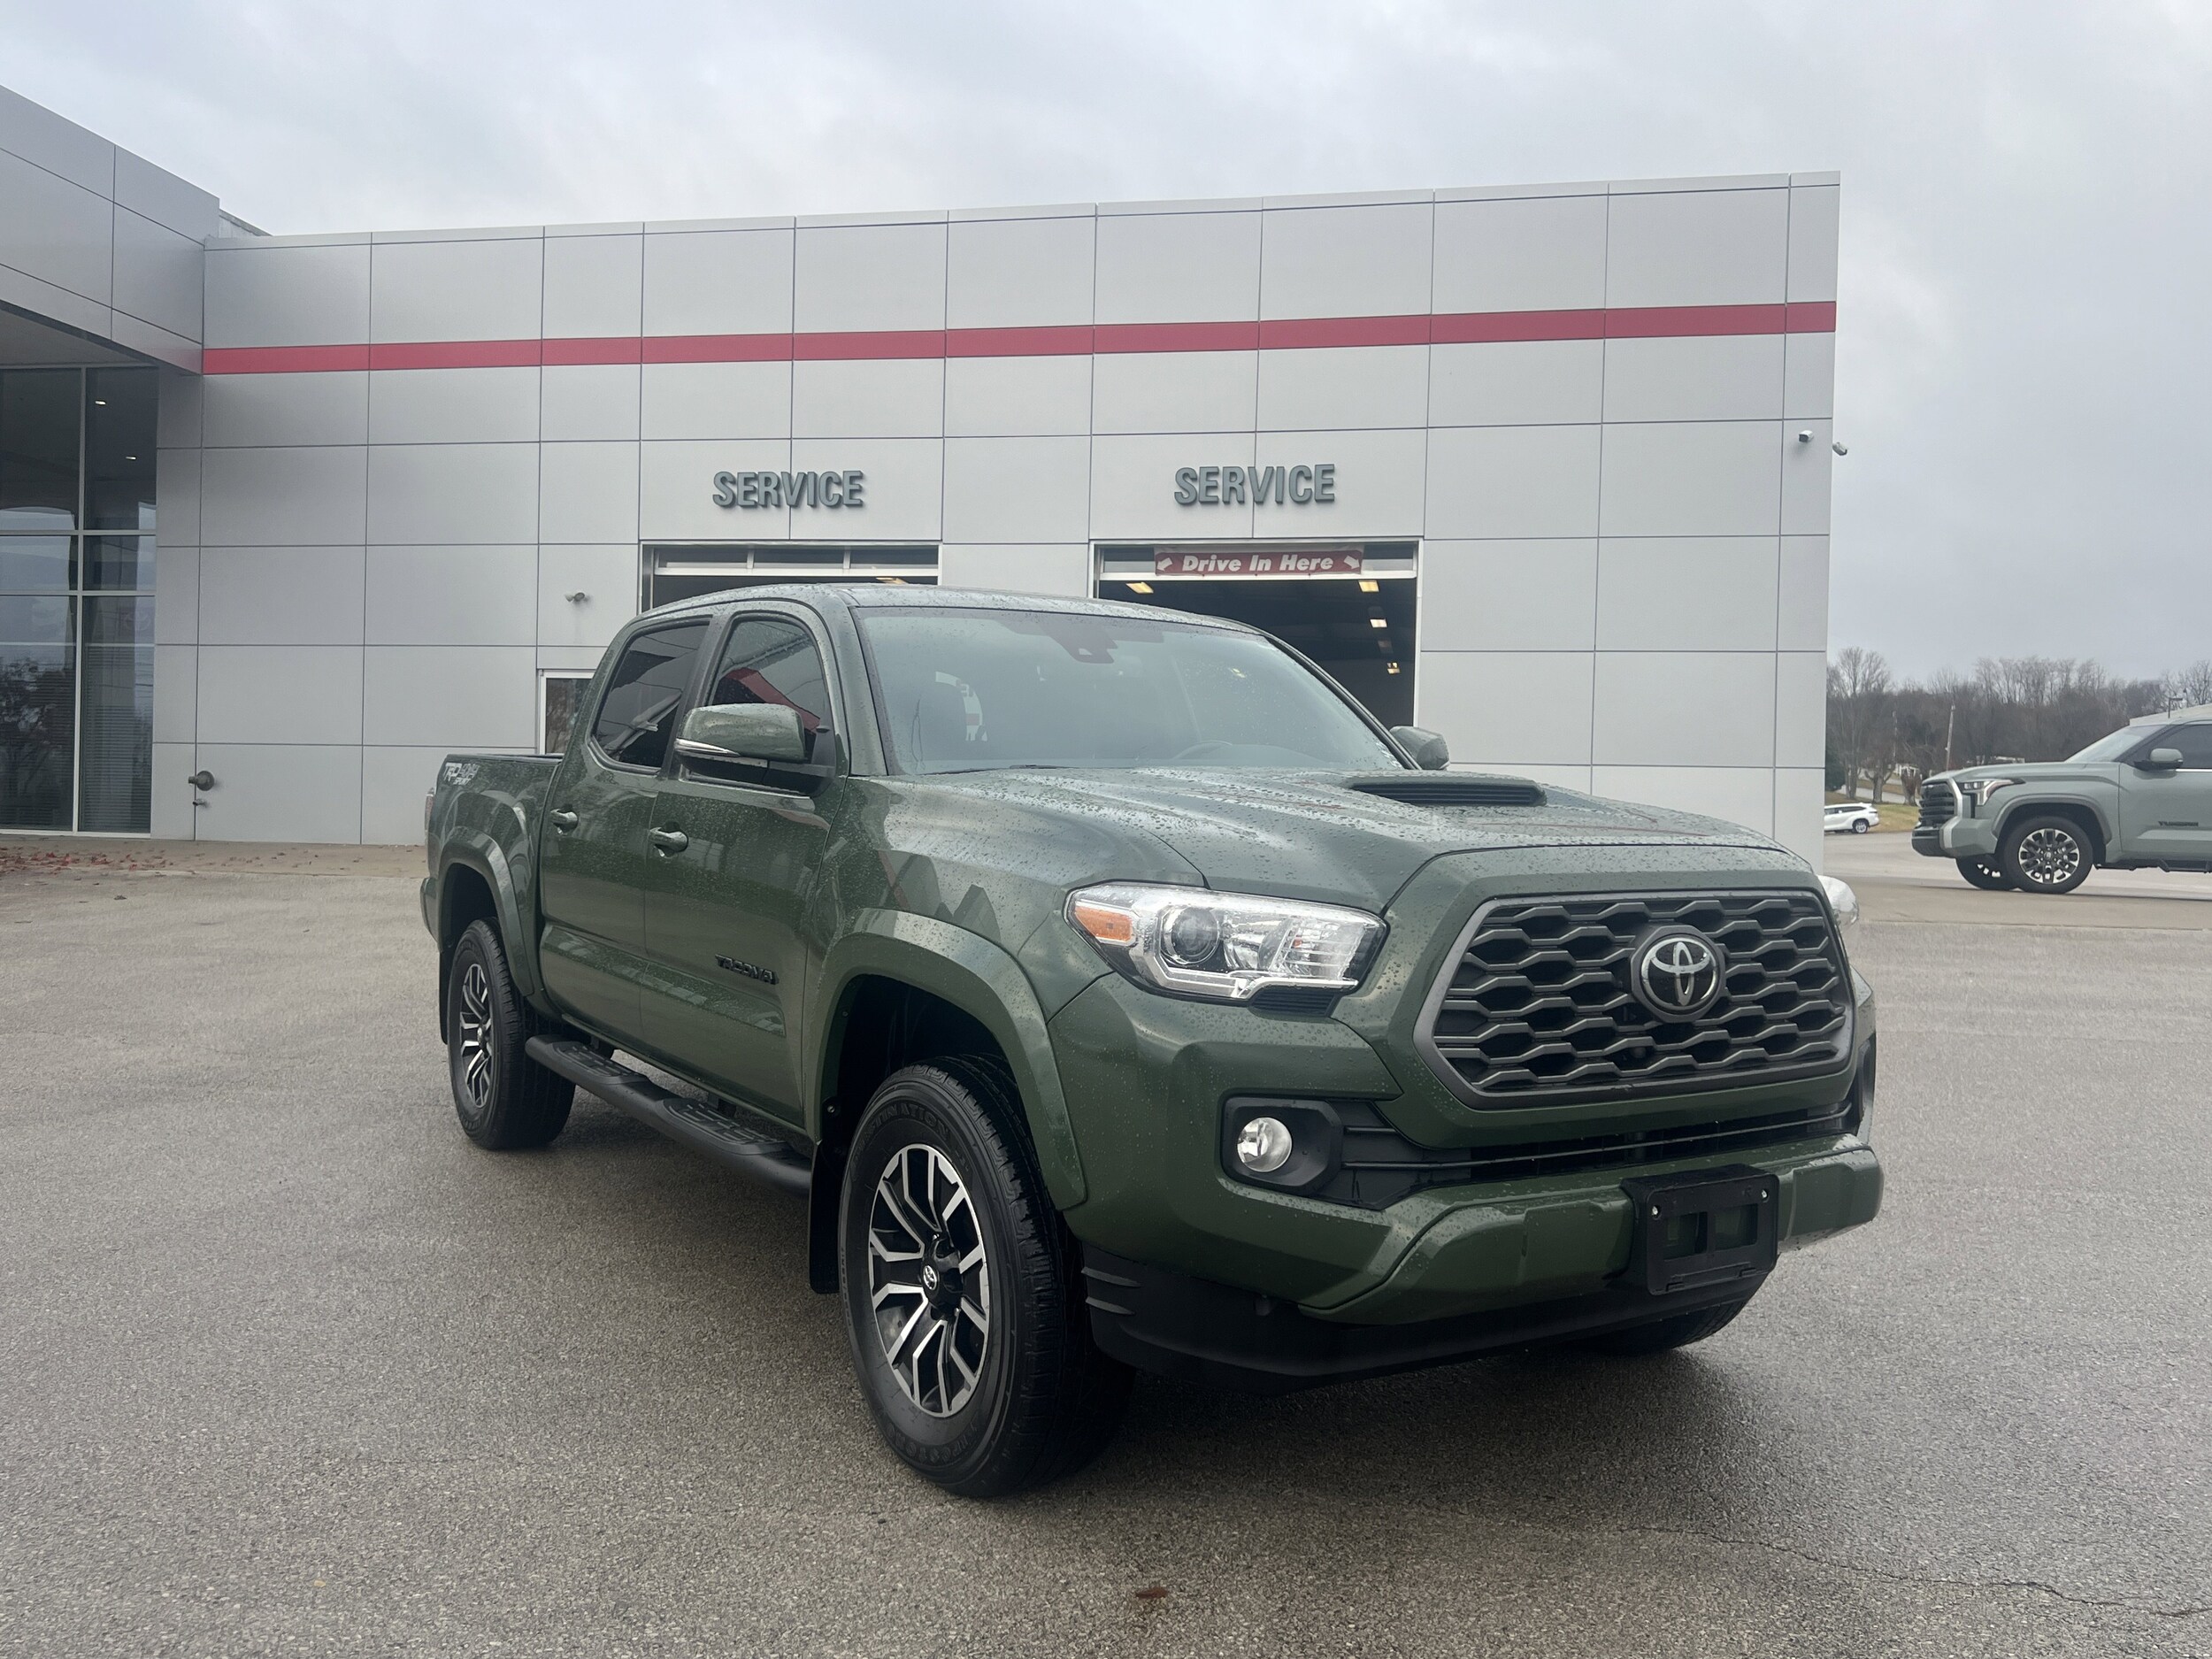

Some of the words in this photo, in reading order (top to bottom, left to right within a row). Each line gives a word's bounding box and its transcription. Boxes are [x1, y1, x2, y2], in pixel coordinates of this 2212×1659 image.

[712, 471, 864, 508] SERVICE
[1174, 464, 1335, 504] SERVICE
[1182, 555, 1241, 572] Drive
[1249, 555, 1271, 572] In
[1279, 554, 1333, 571] Here
